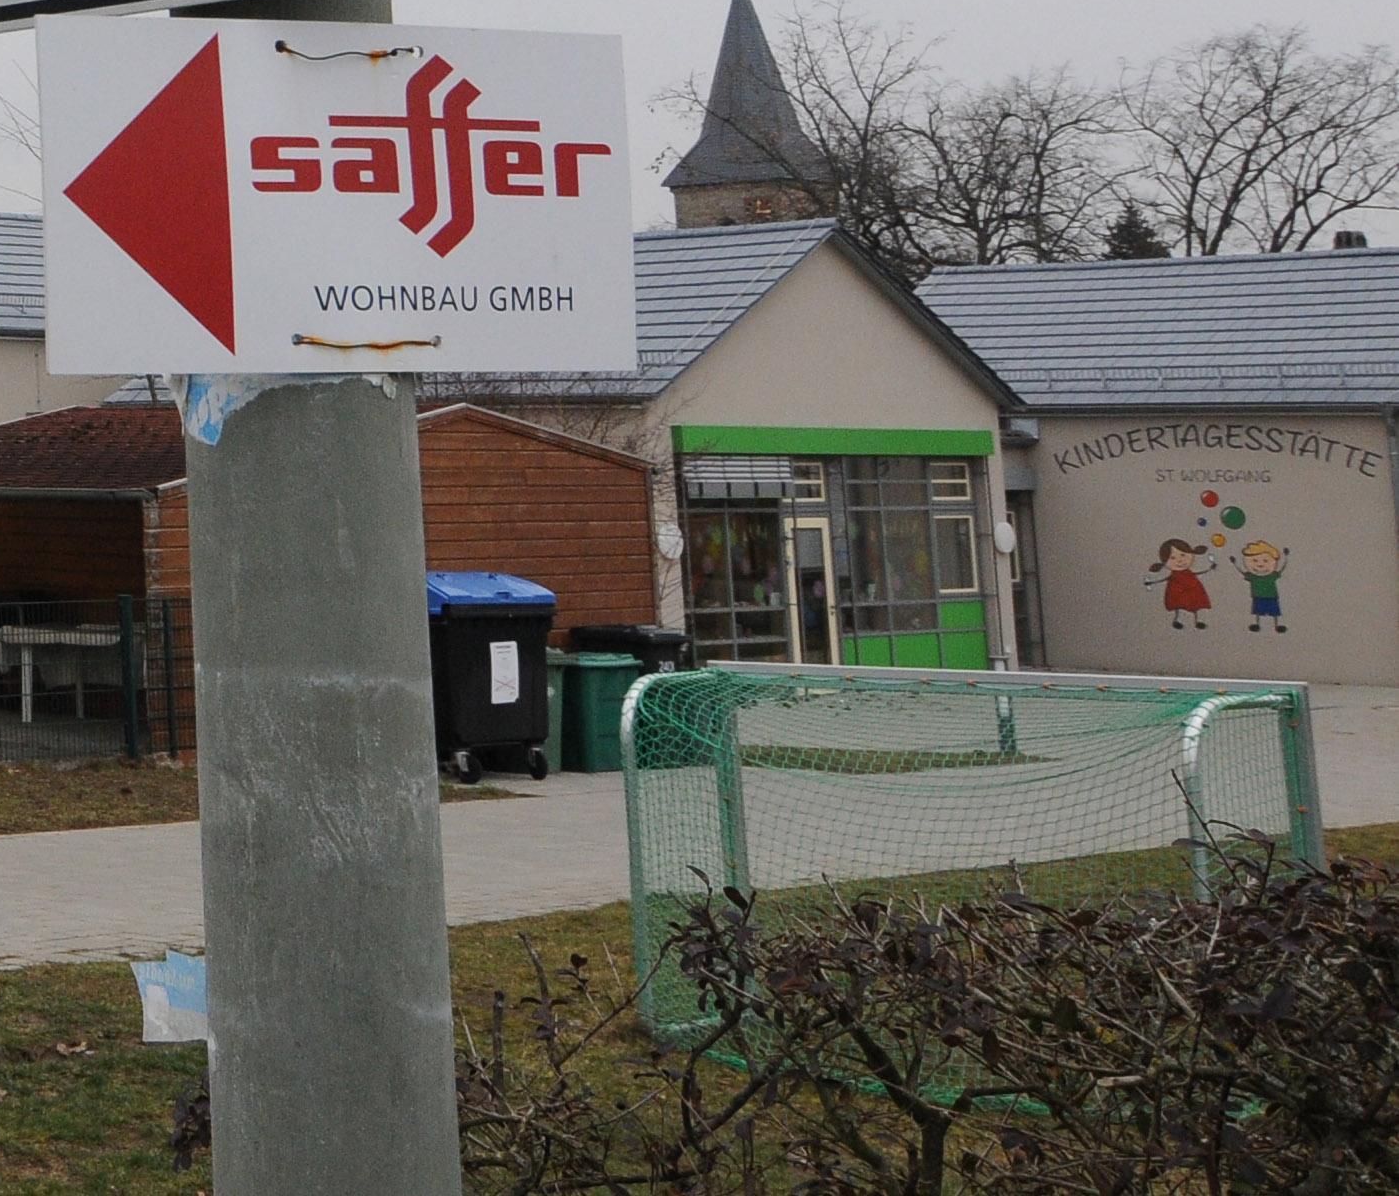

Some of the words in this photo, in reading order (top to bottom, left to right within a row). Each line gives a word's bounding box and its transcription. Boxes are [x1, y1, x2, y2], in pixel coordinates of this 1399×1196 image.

[249, 54, 612, 259] saffer
[314, 285, 479, 312] WOHNBAU
[489, 286, 574, 312] GMBH
[1053, 423, 1383, 478] KINDERTAGESSTÄTTE
[1180, 469, 1271, 483] WOLFGANG
